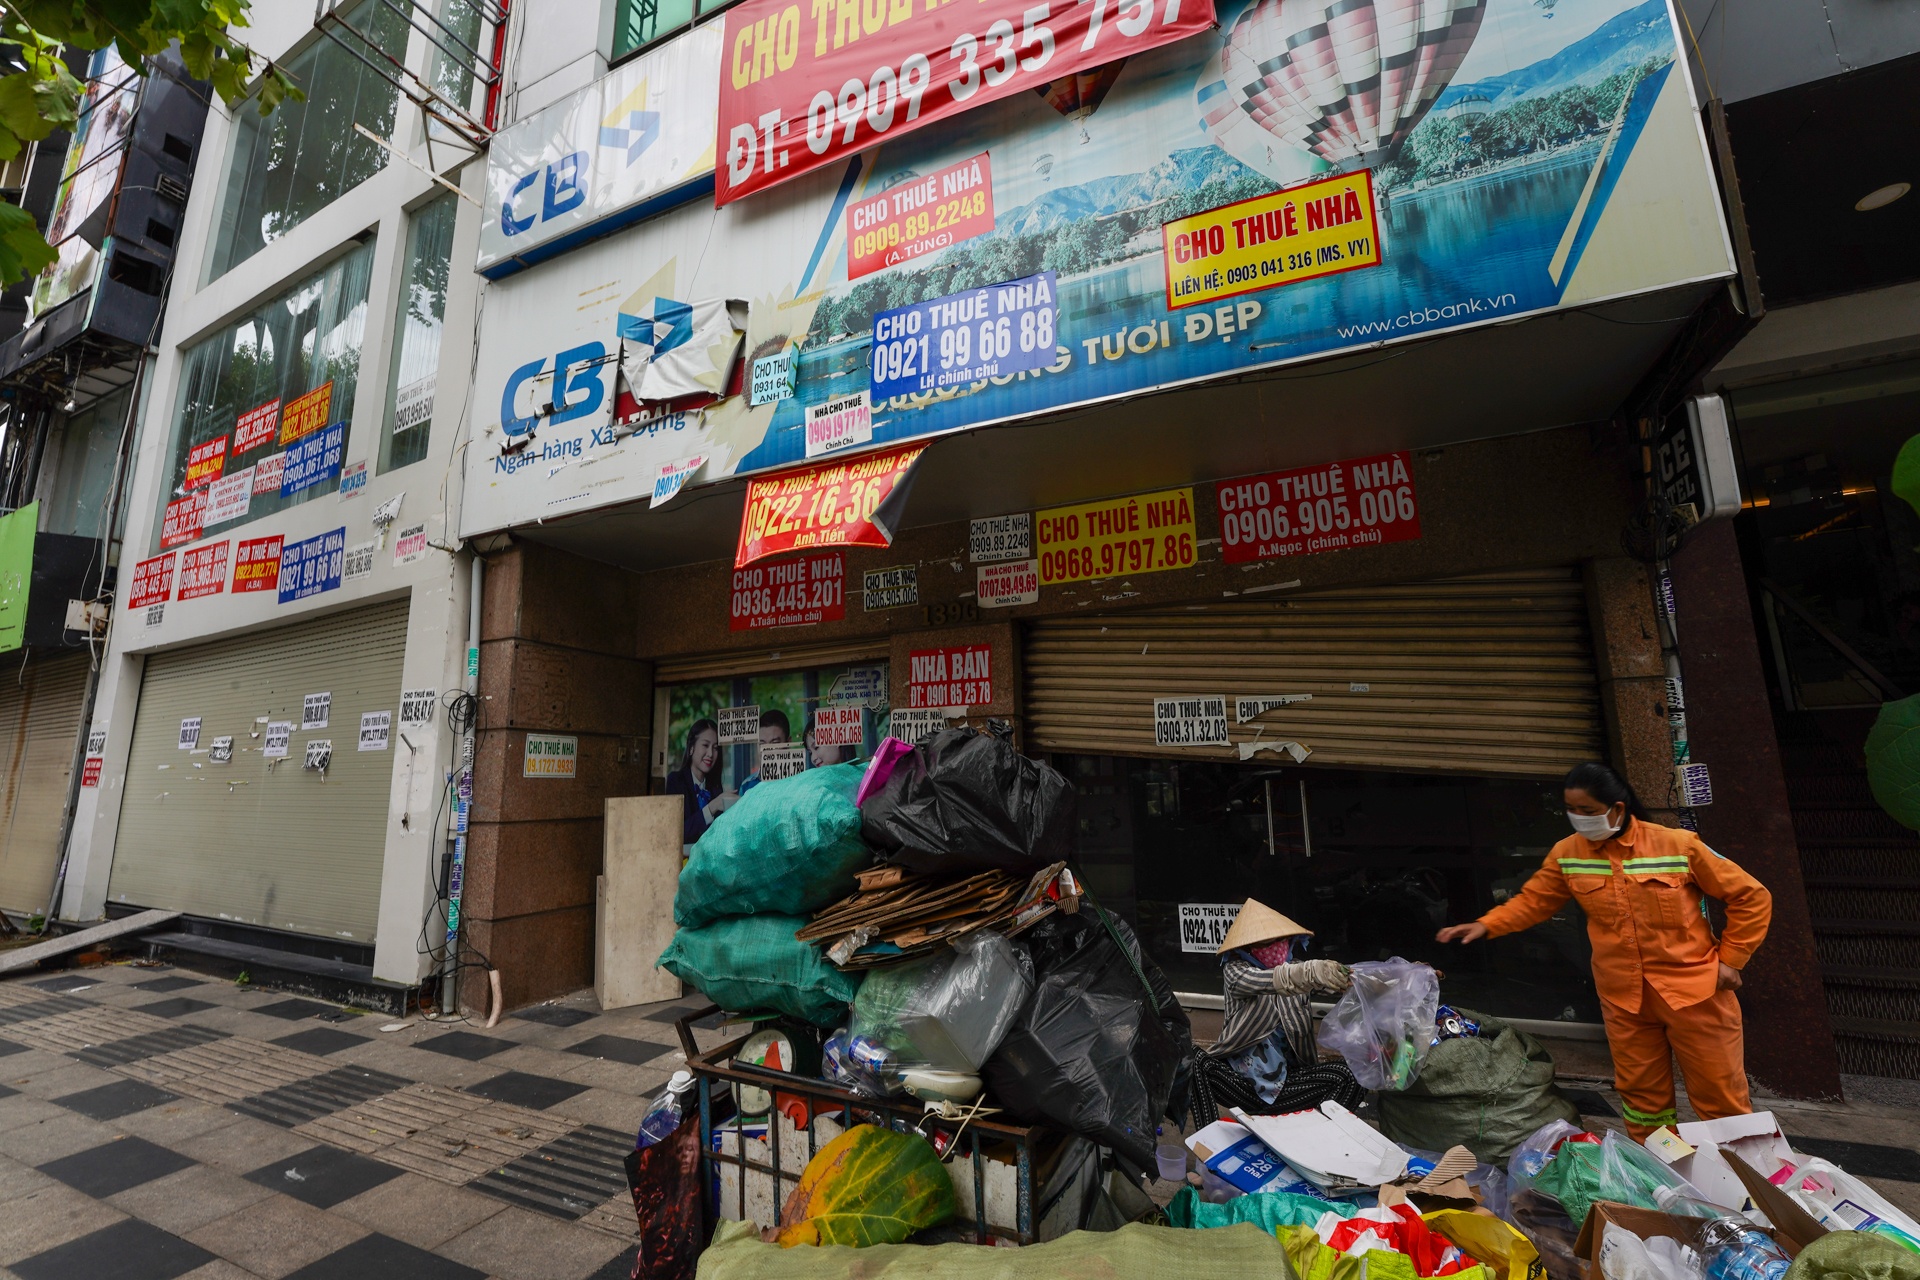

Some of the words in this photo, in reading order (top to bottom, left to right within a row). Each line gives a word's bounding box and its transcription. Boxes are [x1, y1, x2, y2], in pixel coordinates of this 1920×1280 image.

[732, 5, 800, 90] CHO
[726, 108, 789, 188] ĐT:
[806, 53, 931, 155] 0909
[948, 3, 1056, 102] 335
[502, 150, 590, 237] CB
[854, 199, 887, 231] CHO
[893, 176, 938, 215] THUÊ
[943, 159, 983, 197] NHÀ
[854, 191, 986, 259] 0909.89.2248
[1174, 224, 1225, 264] CHO
[1232, 201, 1299, 250] THUÊ
[1305, 186, 1363, 232] NHÀ
[885, 231, 953, 267] (A.TÙNG)
[1174, 275, 1201, 297] LIÊN
[1204, 268, 1224, 292] HỆ:
[1227, 263, 1258, 285] 0903
[1261, 257, 1284, 276] 041
[1288, 251, 1312, 271] 316
[1316, 245, 1345, 266] (MS.
[1347, 237, 1371, 257] VY)
[876, 310, 922, 342] CHO
[928, 290, 989, 330] THUÊ
[998, 276, 1052, 314] NHÀ
[1337, 291, 1517, 340] www.cbbank.vn
[1082, 316, 1170, 366] TƯƠI
[1184, 300, 1263, 344] ĐẸP
[873, 335, 930, 384] 0921
[940, 326, 971, 370] 99
[979, 316, 1011, 361] 66
[1020, 308, 1053, 353] 88
[754, 362, 772, 379] CHO
[773, 354, 792, 375] THU
[920, 375, 935, 390] LH
[938, 368, 972, 386] chính
[975, 360, 999, 378] chủ
[500, 341, 606, 437] CB
[754, 380, 774, 394] 0931
[759, 392, 780, 403] ANH
[815, 404, 829, 418] NHÀ
[829, 401, 844, 415] CHO
[844, 395, 862, 412] THUÊ
[808, 415, 832, 446] 0909
[844, 410, 856, 434] 77
[286, 446, 302, 468] CHO
[304, 432, 325, 460] THUÊ
[325, 423, 342, 448] NHÀ
[542, 437, 583, 461] hàng
[825, 439, 842, 450] Chính
[842, 436, 854, 446] Chủ
[283, 447, 341, 486] 0908.061.068
[752, 482, 778, 500] CHO
[782, 470, 817, 495] THUÊ
[817, 463, 846, 488] NHÀ
[849, 456, 894, 479] CHÍNH
[1220, 481, 1270, 511] CHO
[1277, 464, 1345, 501] THUÊ
[1352, 453, 1409, 490] NHÀ
[970, 519, 988, 536] CHO
[989, 515, 1010, 533] THUÊ
[1012, 514, 1029, 531] NHÀ
[1039, 514, 1079, 545] CHO
[1086, 500, 1139, 537] THUÊ
[1147, 491, 1191, 529] NHÀ
[1223, 486, 1415, 546] 0906.905.006
[283, 547, 300, 566] CHO
[302, 536, 323, 560] THUÊ
[325, 529, 343, 554] NHÀ
[794, 533, 816, 547] Anh
[820, 527, 845, 543] Tiến
[970, 532, 1029, 554] 0909.89.2248
[1258, 540, 1303, 557] A.Ngọc
[1307, 533, 1349, 551] (chính
[1352, 528, 1382, 544] chủ)
[238, 546, 250, 563] CHO
[977, 552, 1002, 560] Chính
[1005, 549, 1023, 559] Chủ
[1041, 532, 1193, 582] 0968.9797.86
[280, 563, 302, 593] 0921
[303, 559, 315, 586] 99
[316, 555, 328, 583] 66
[330, 550, 342, 579] 88
[733, 568, 763, 590] CHO
[768, 558, 807, 586] THUÊ
[811, 552, 844, 579] NHÀ
[866, 574, 880, 590] CHO
[985, 565, 998, 577] NHÀ
[998, 565, 1012, 575] CHO
[1013, 562, 1029, 573] THUÊ
[732, 579, 842, 618] 0936.445.201
[866, 586, 918, 610] 0906.905.006
[979, 573, 1037, 599] 0707.99.49.69
[995, 596, 1009, 605] Chính
[750, 612, 776, 627] A.Tuấn
[778, 610, 803, 625] (chính
[805, 608, 822, 623] chủ)
[911, 649, 948, 684] NHÀ
[952, 646, 990, 681] BÁN
[404, 691, 413, 699] CHO
[910, 685, 925, 708] ĐT:
[926, 685, 949, 706] 0901
[950, 683, 962, 705] 85
[964, 682, 977, 704] 25
[979, 681, 991, 704] 78
[720, 711, 731, 721] CHO
[732, 708, 746, 719] THUÊ
[818, 707, 837, 725] NHÀ
[840, 706, 860, 724] BÁN
[892, 712, 907, 721] CHO
[909, 709, 928, 721] THUÊ
[1158, 702, 1176, 719] CHO
[1178, 698, 1202, 717] THUÊ
[1204, 697, 1224, 717] NHÀ
[1239, 700, 1260, 718] CHO
[719, 719, 758, 737] 0931.339.227
[816, 725, 862, 745] 0908.061.068
[1157, 718, 1227, 743] 0909.31.32.03
[528, 740, 542, 755] CHO
[544, 739, 561, 755] THUÊ
[562, 740, 574, 755] NHÀ
[776, 751, 790, 760] THUÊ
[527, 758, 574, 773] 09.1727.9933
[1182, 907, 1200, 917] CHO
[1203, 905, 1225, 917] THUÊ
[1243, 1165, 1264, 1179] chai
[1251, 1159, 1273, 1173] 28
